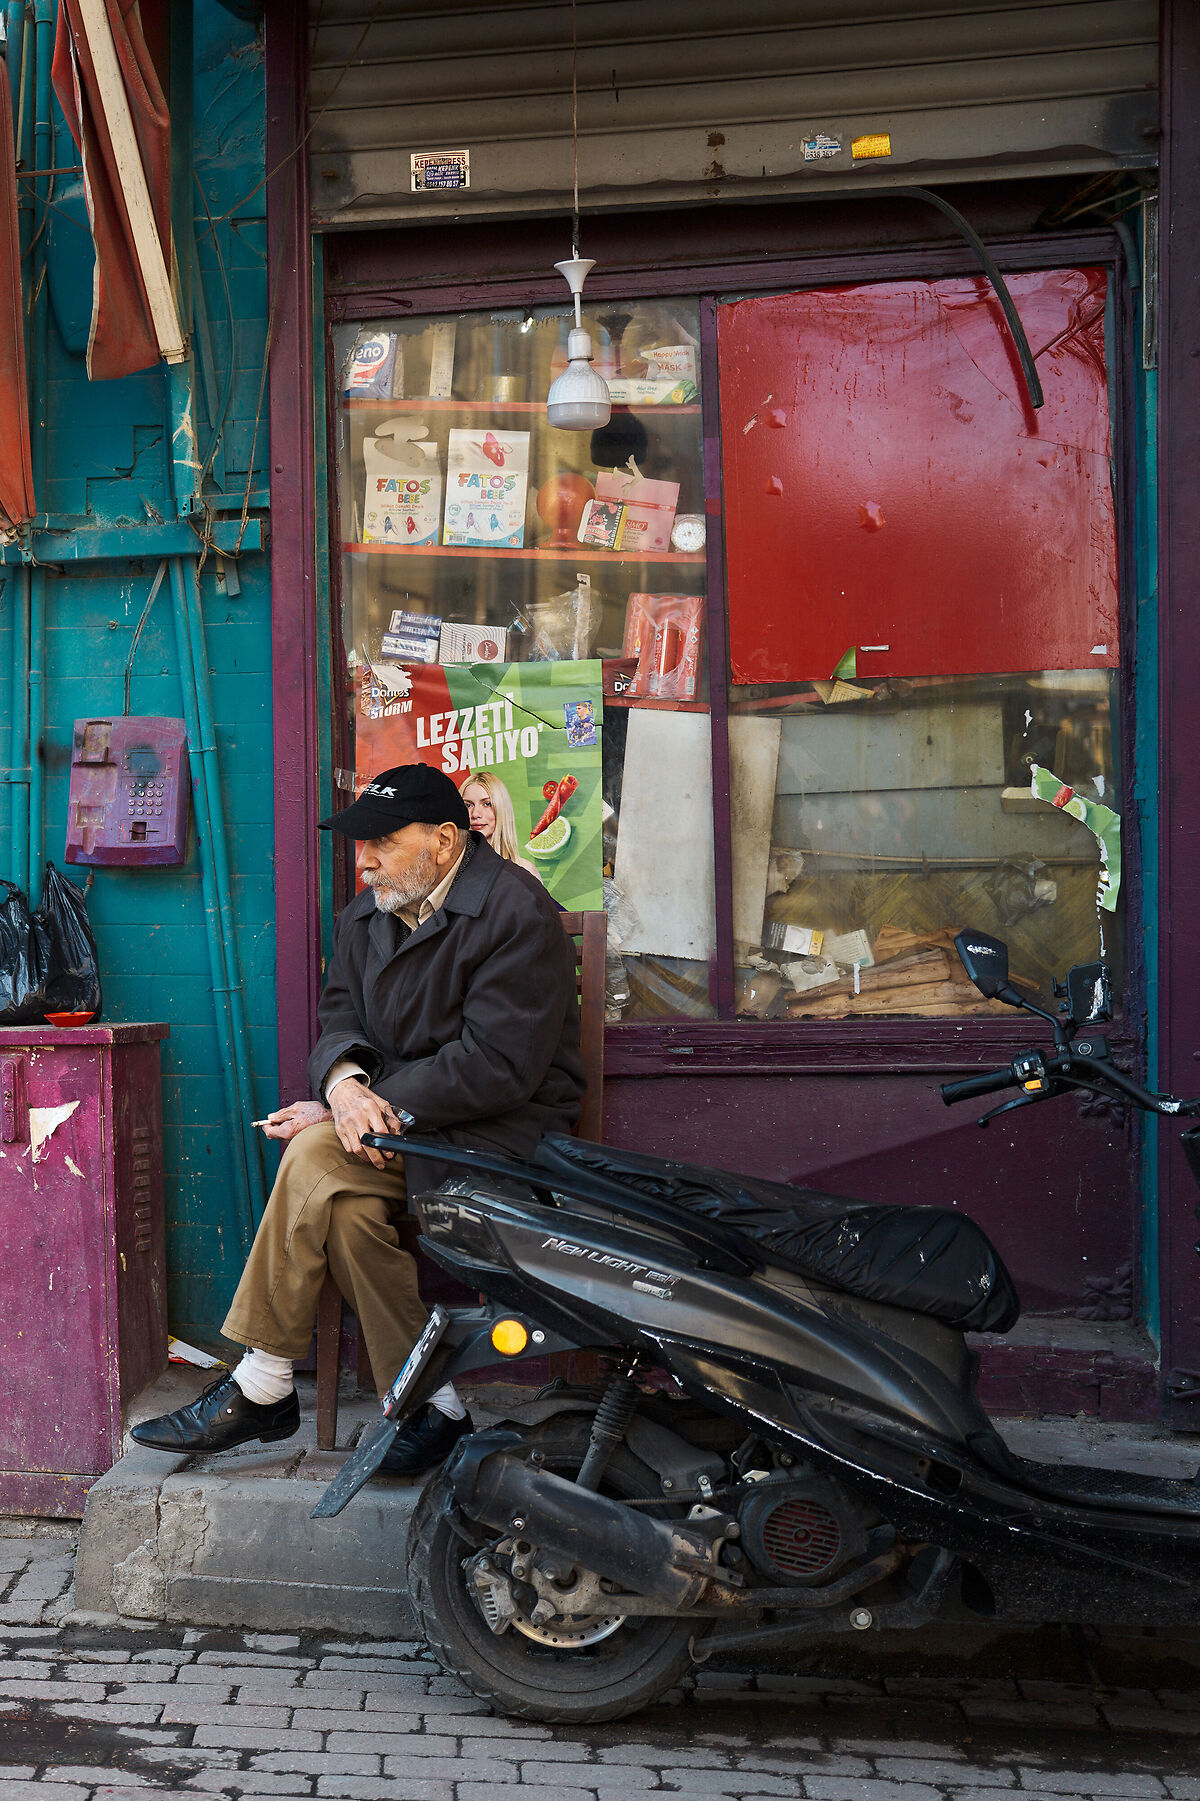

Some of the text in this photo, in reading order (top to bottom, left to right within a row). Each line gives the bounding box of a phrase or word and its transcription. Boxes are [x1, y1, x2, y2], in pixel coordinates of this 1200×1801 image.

[397, 493, 421, 504] BEBE
[480, 489, 505, 500] BEBE
[416, 692, 514, 748] LEZZETİ
